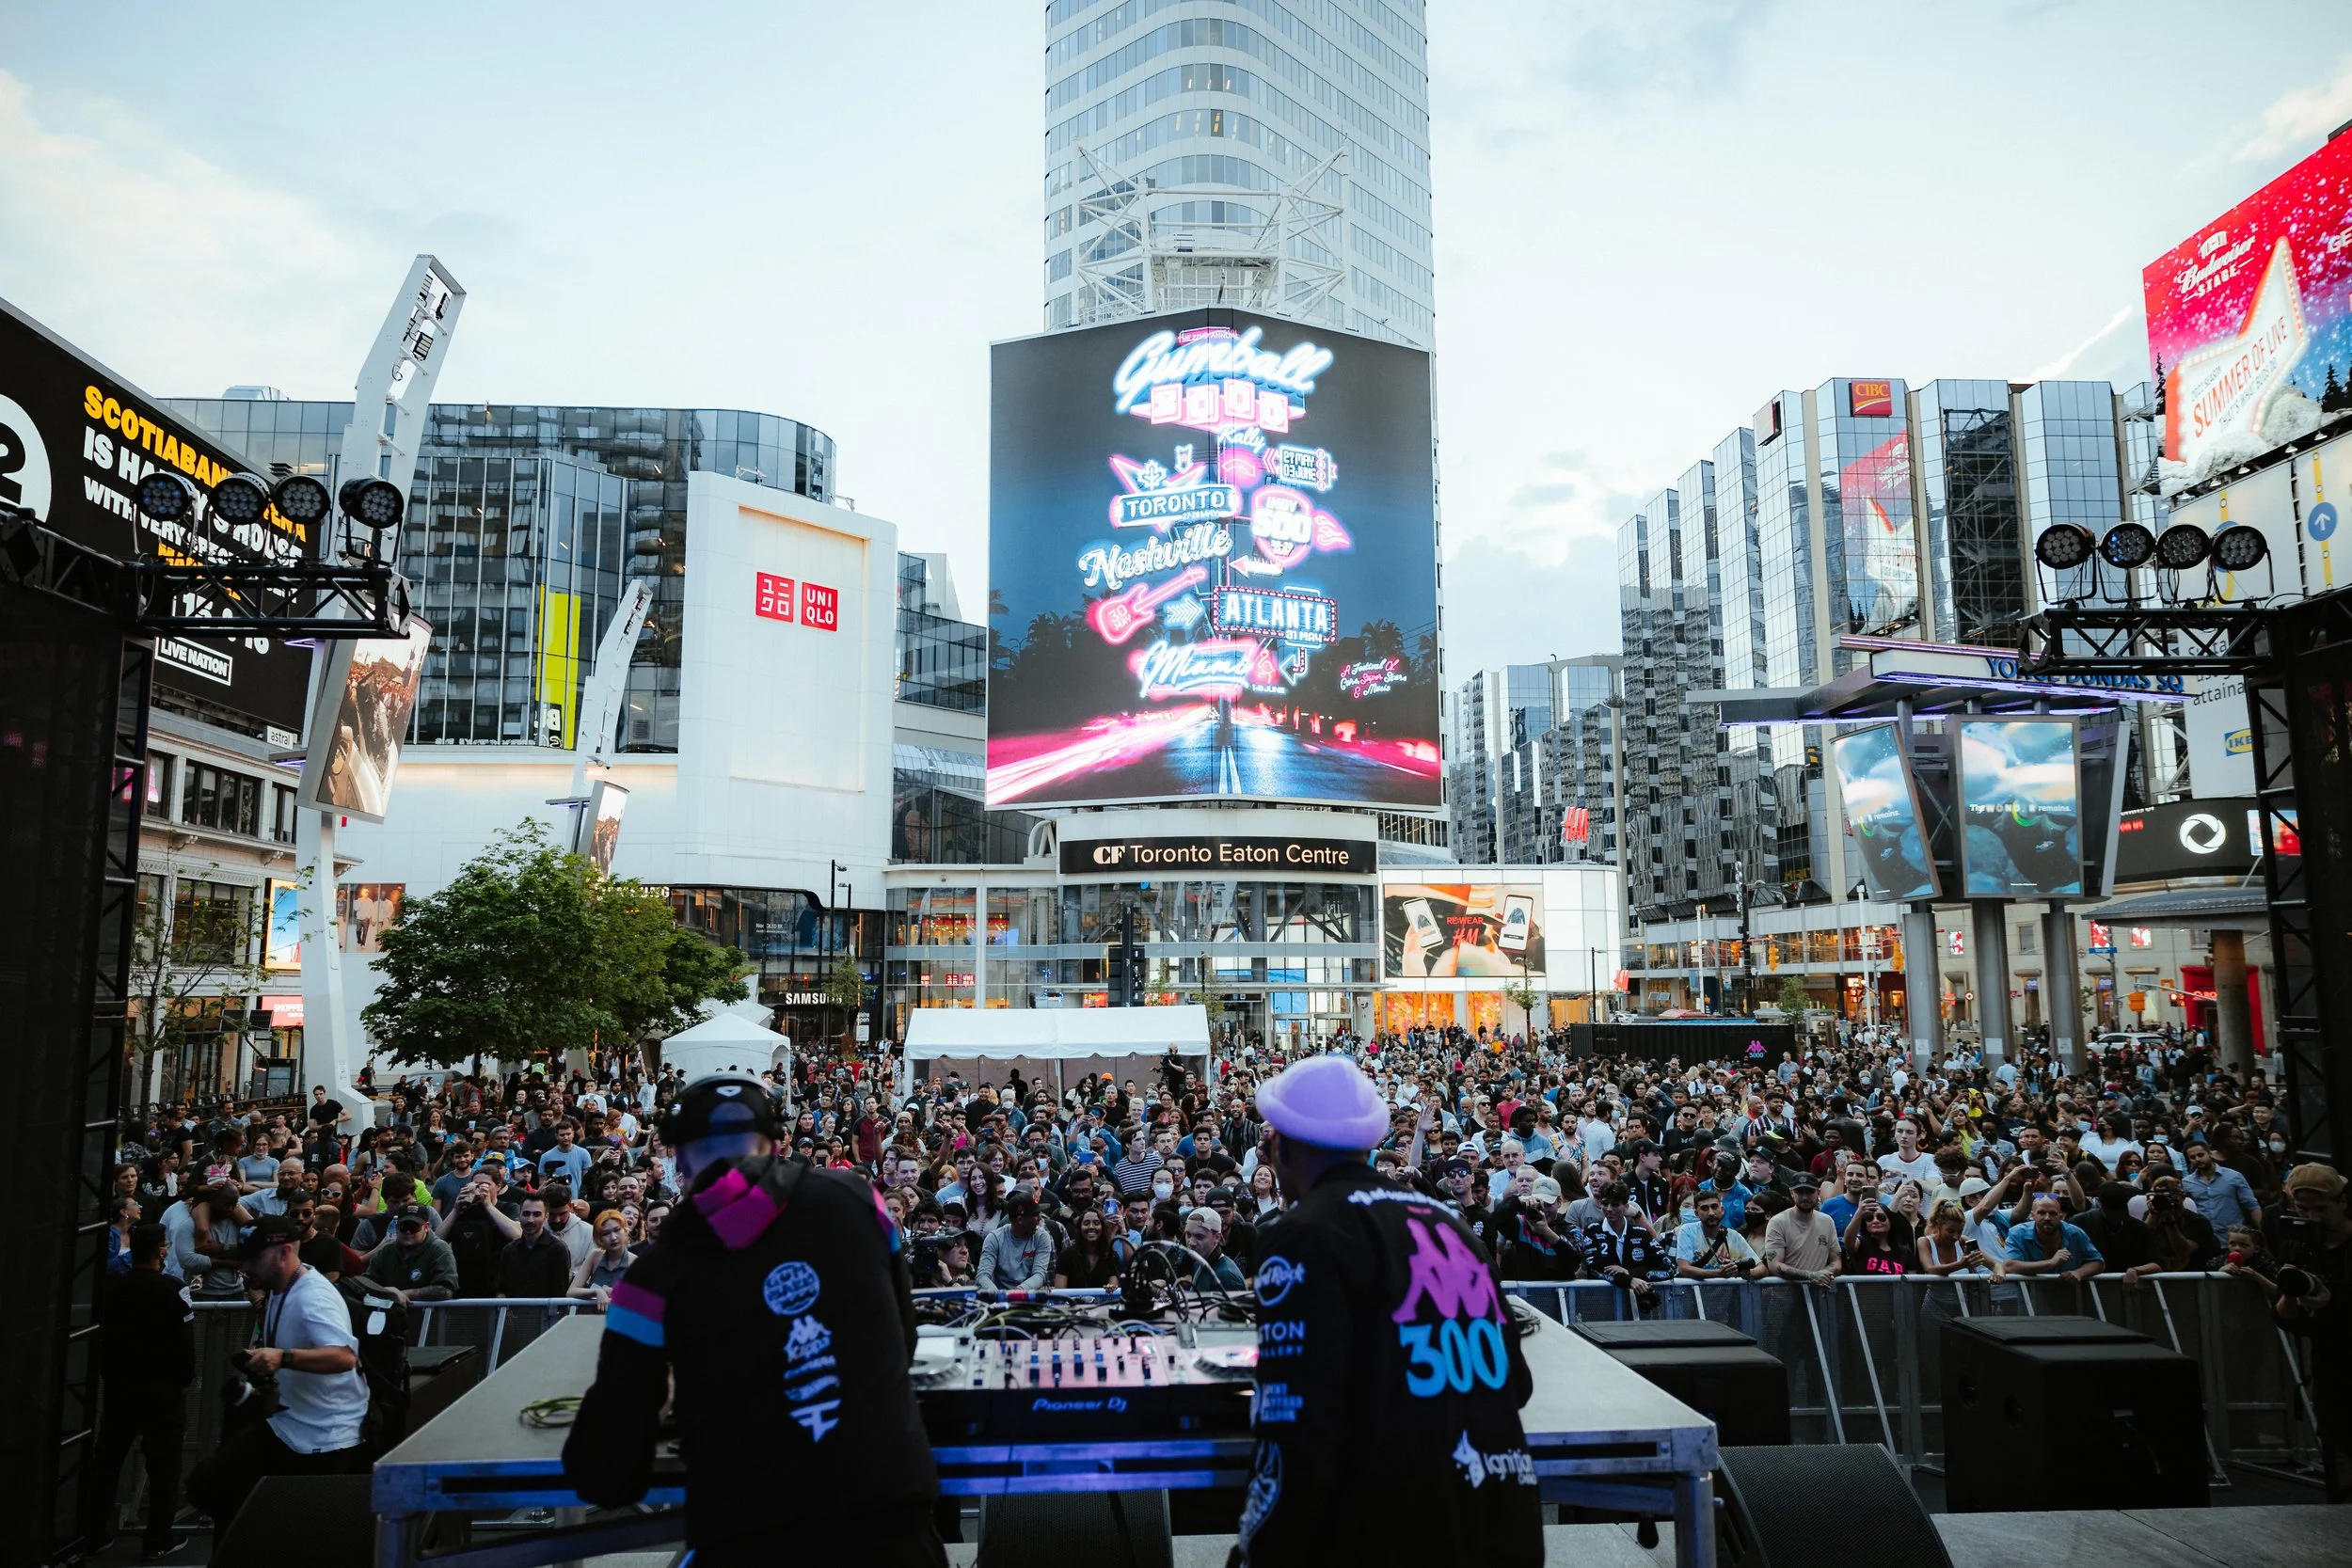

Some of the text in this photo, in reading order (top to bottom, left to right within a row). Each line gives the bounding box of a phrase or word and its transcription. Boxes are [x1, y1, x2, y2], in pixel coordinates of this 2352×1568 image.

[2178, 236, 2256, 293] Budweiser
[2198, 263, 2238, 297] STAGE
[1115, 325, 1334, 415] Gumball
[2193, 316, 2287, 437] SUMMER OF LIVE
[1855, 384, 1889, 396] CIBC
[83, 425, 113, 469] IS
[84, 386, 233, 488] SCOTIABAN
[1218, 426, 1265, 452] Rally
[1283, 451, 1295, 464] 27
[1296, 467, 1316, 483] JUNE
[84, 475, 134, 521] WITH
[141, 512, 186, 547] VERY
[1126, 490, 1225, 518] TORONTO
[263, 501, 307, 543] ENA
[1251, 508, 1312, 544] 500
[1078, 521, 1234, 591] Nashville
[761, 578, 789, 598] ユニ
[806, 588, 833, 608] UNI
[760, 595, 790, 616] クロ
[806, 605, 834, 625] QLO
[1108, 604, 1128, 623] 30
[1225, 593, 1328, 632] ATLANTA
[1113, 614, 1132, 631] MAY
[1286, 629, 1322, 643] 31 MAY
[161, 638, 229, 677] LIVE NATION
[1341, 665, 1351, 677] A
[1351, 658, 1388, 675] Festival
[1139, 639, 1253, 698] Miami
[1360, 673, 1384, 685] Super
[1384, 671, 1407, 683] Stars
[1354, 683, 1391, 699] & Music
[2156, 675, 2185, 693] SQ
[270, 730, 291, 745] astral
[1093, 844, 1349, 865] CF Toronto Eaton Centre
[786, 992, 843, 1005] SAMSU
[1601, 1243, 1609, 1255] 2
[1867, 1257, 1904, 1276] GAP
[1032, 1397, 1104, 1412] Pioneer
[1483, 1449, 1534, 1481] Ignitio
